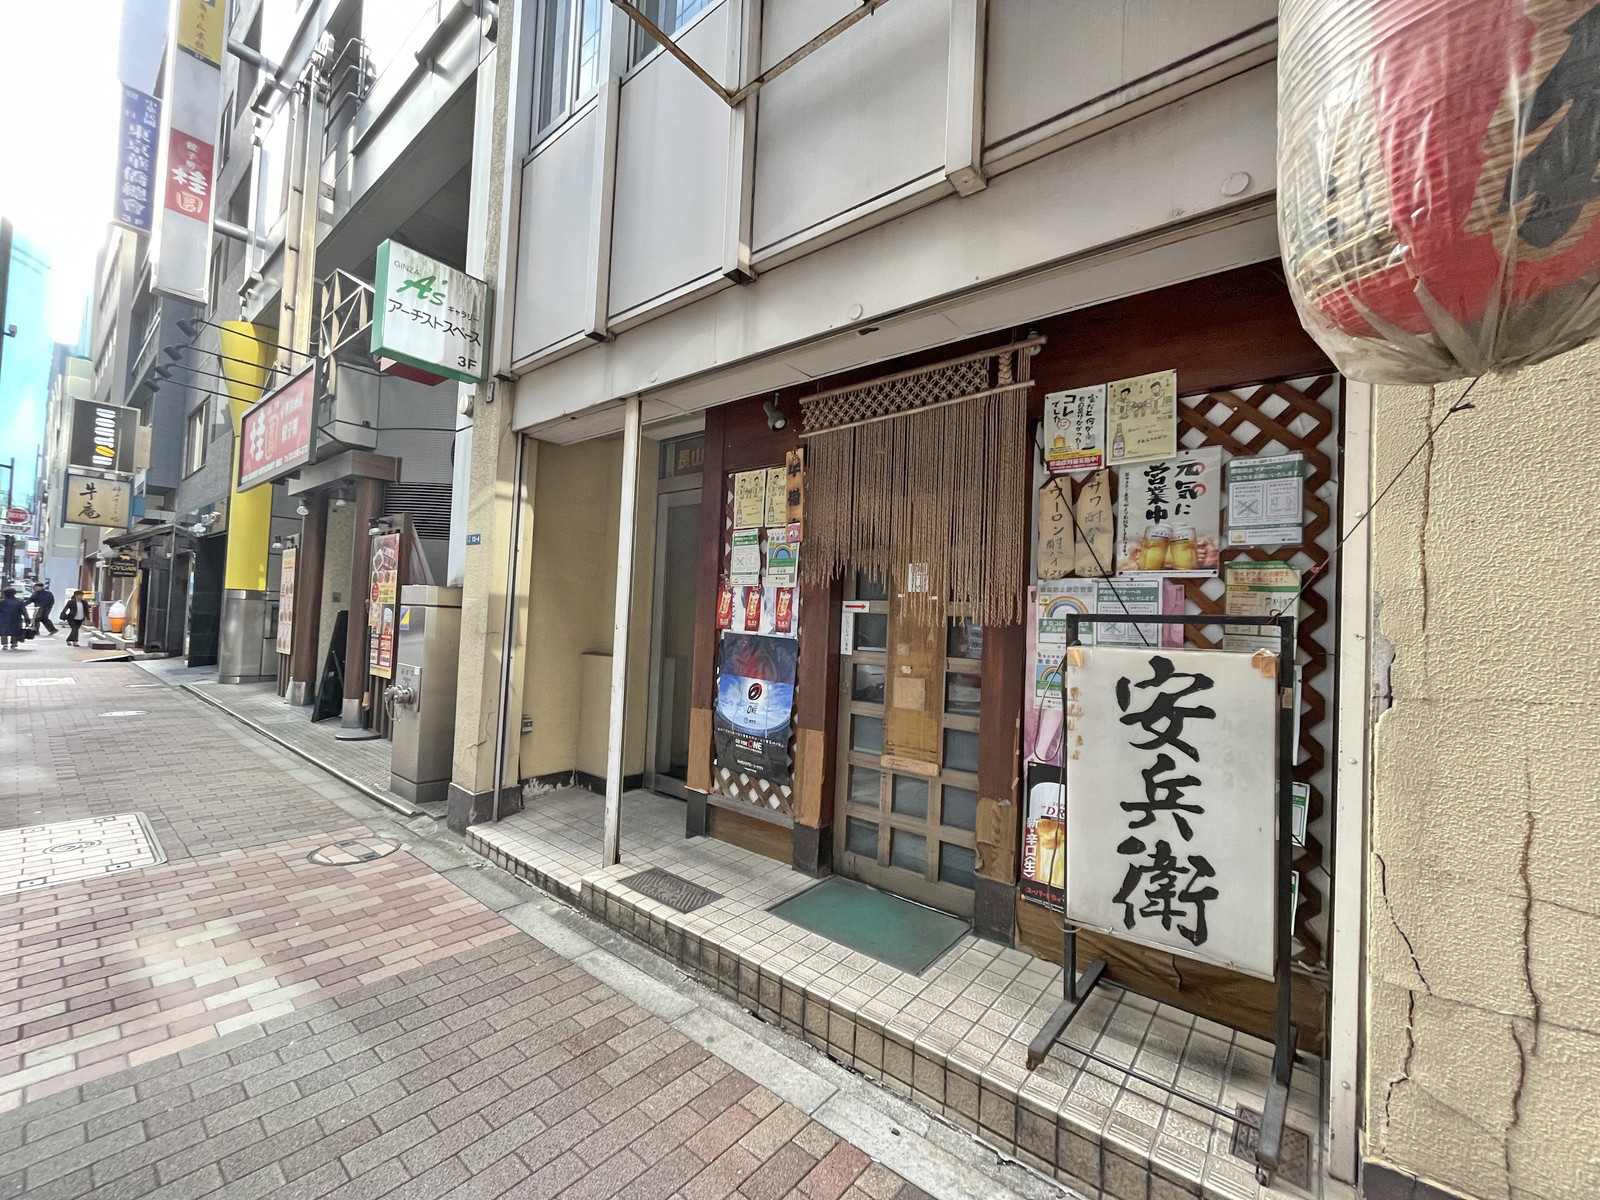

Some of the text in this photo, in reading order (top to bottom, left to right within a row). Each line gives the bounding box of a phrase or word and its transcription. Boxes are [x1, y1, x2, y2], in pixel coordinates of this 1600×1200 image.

[393, 260, 421, 275] GINZA
[396, 275, 448, 306] A's
[388, 298, 482, 347] アーチストスペース
[448, 306, 480, 322] ギャラリー
[457, 356, 478, 370] 3F
[1063, 394, 1077, 417] コレ
[92, 407, 117, 467] DOUTOR
[78, 482, 101, 519] 牛庵
[1143, 461, 1171, 524] 営業中
[1174, 459, 1207, 516] 元気に
[1046, 485, 1065, 567] ウーロン酎ハイ
[1085, 481, 1103, 545] サワ酎ハイ
[746, 705, 758, 715] ONE
[747, 740, 763, 751] ONE
[1111, 655, 1220, 947] 安兵衛
